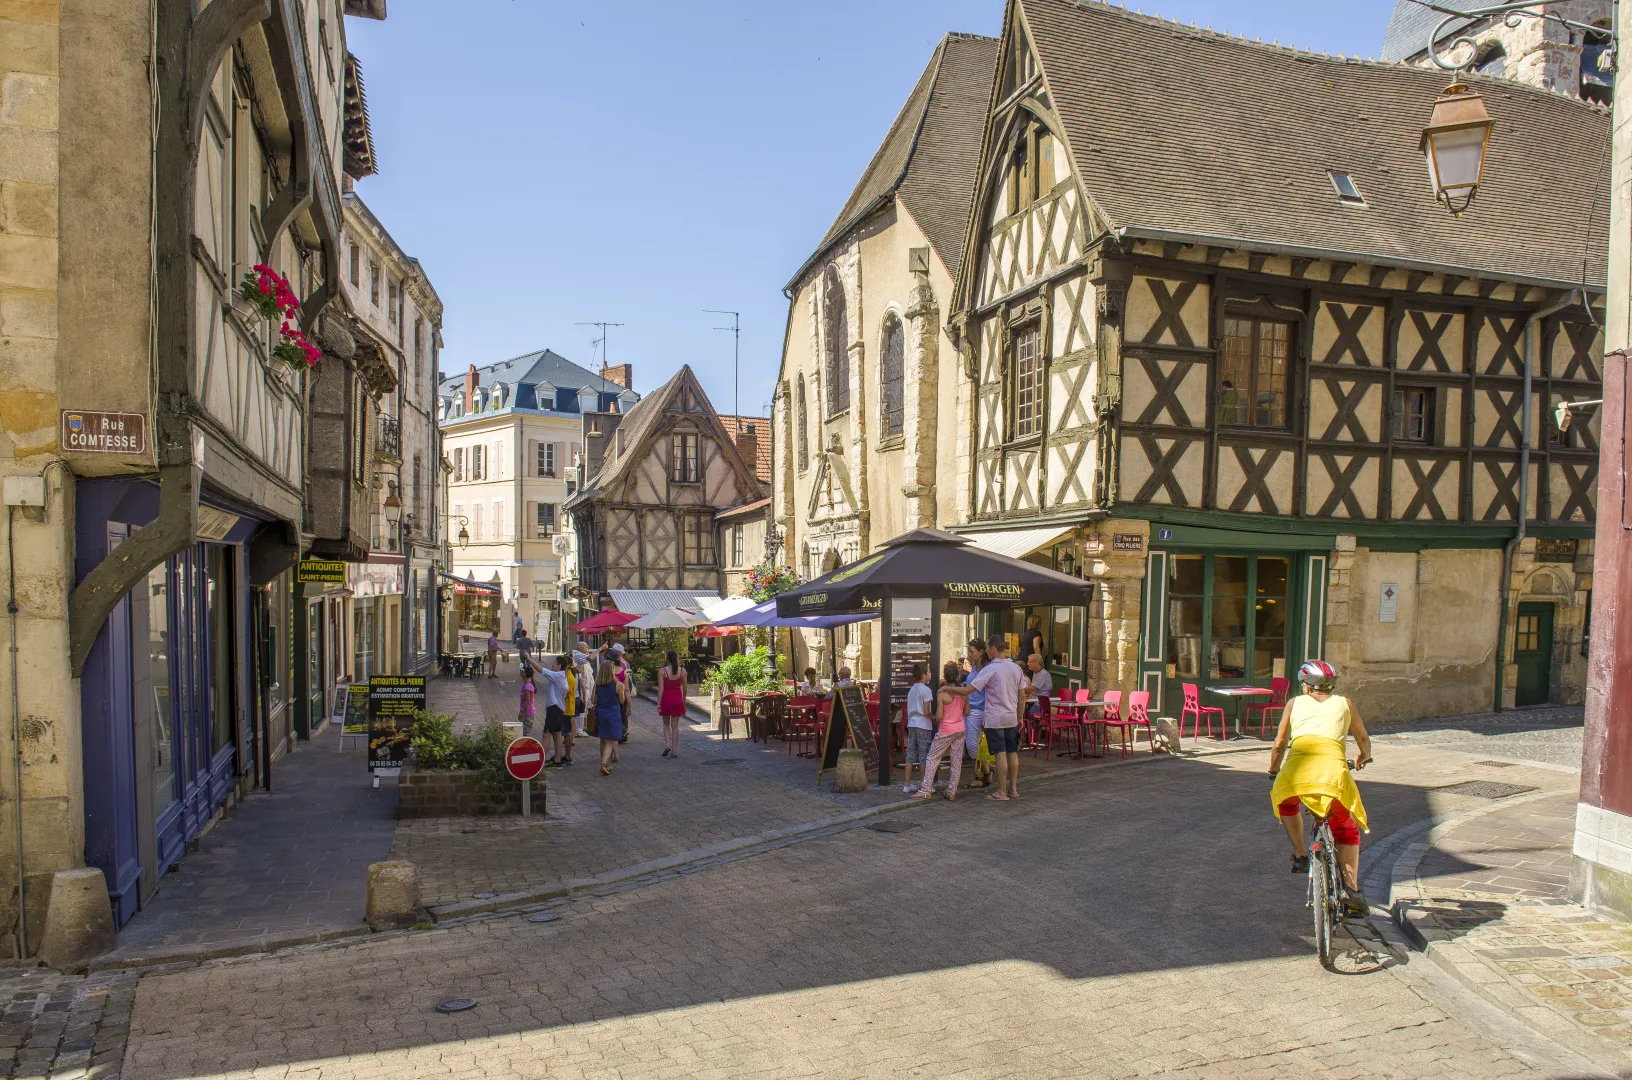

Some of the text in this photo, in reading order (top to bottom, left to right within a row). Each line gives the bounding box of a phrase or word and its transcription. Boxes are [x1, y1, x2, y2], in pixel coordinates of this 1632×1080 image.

[102, 418, 125, 431] Rue
[70, 433, 137, 448] COMTESSE
[1163, 531, 1168, 539] 1
[300, 562, 343, 572] ANTIQUITES
[949, 582, 1020, 594] GRIMBERGEN
[371, 677, 399, 685] ANTIQUITÉS
